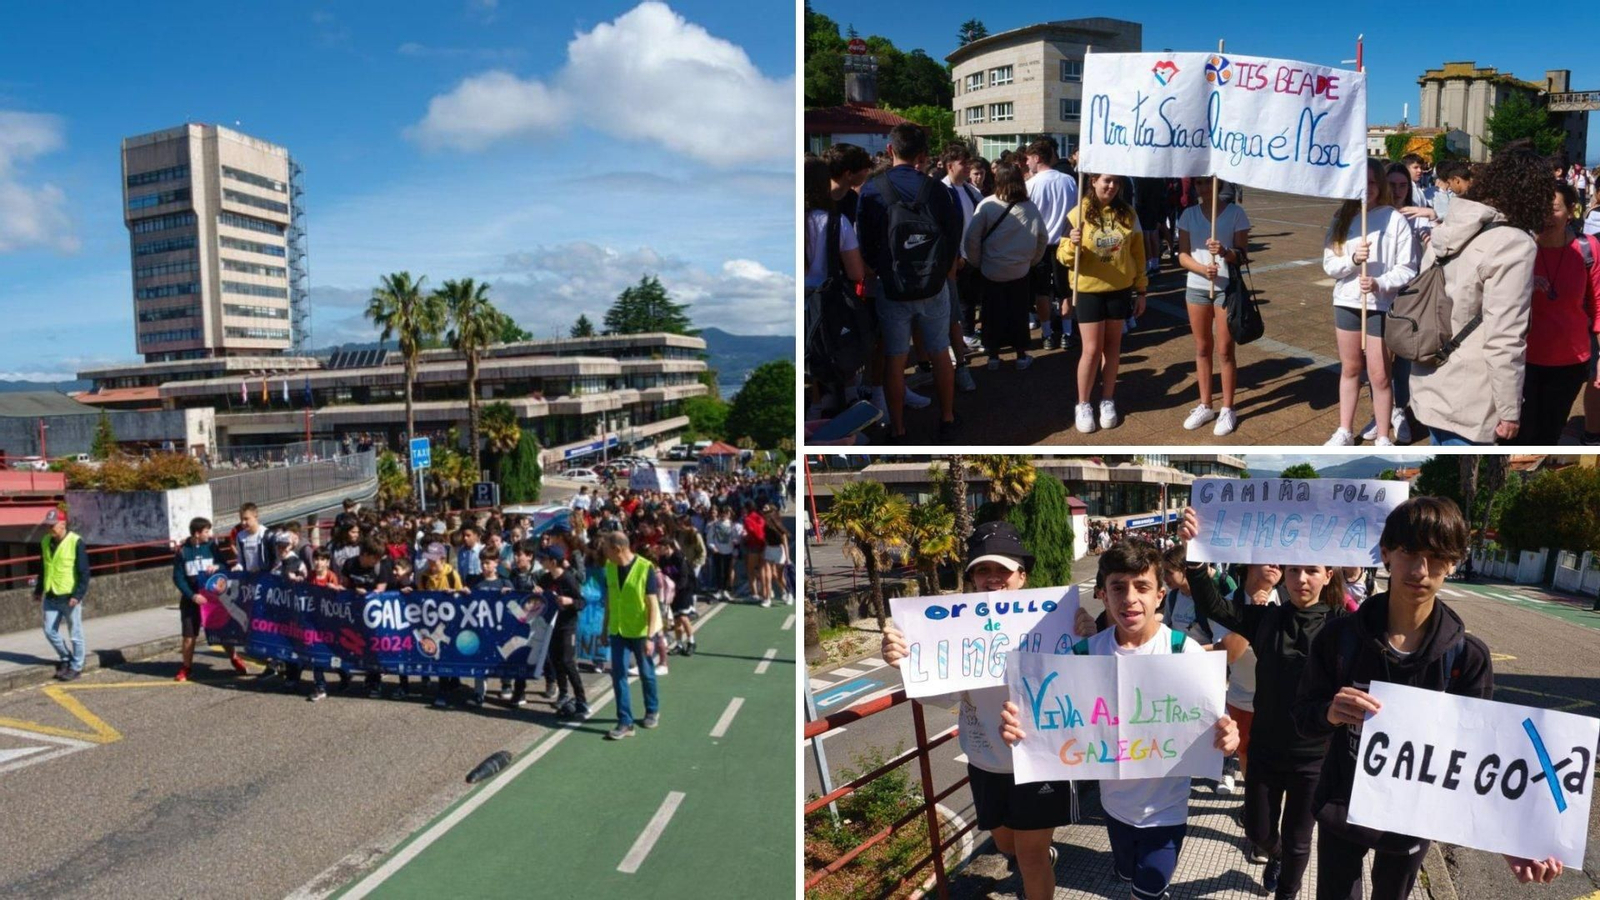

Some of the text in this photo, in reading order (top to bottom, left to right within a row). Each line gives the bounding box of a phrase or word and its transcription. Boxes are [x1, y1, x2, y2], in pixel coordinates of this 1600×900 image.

[1235, 62, 1340, 100] IES BEADE
[1268, 127, 1290, 161] é
[1295, 106, 1350, 168] Nosa
[412, 448, 431, 459] TAXI
[477, 484, 488, 499] P
[1333, 483, 1386, 503] POLA
[460, 600, 504, 630] XA!
[984, 618, 1001, 632] de
[370, 636, 413, 651] 2024
[1059, 738, 1178, 765] GALEGAS
